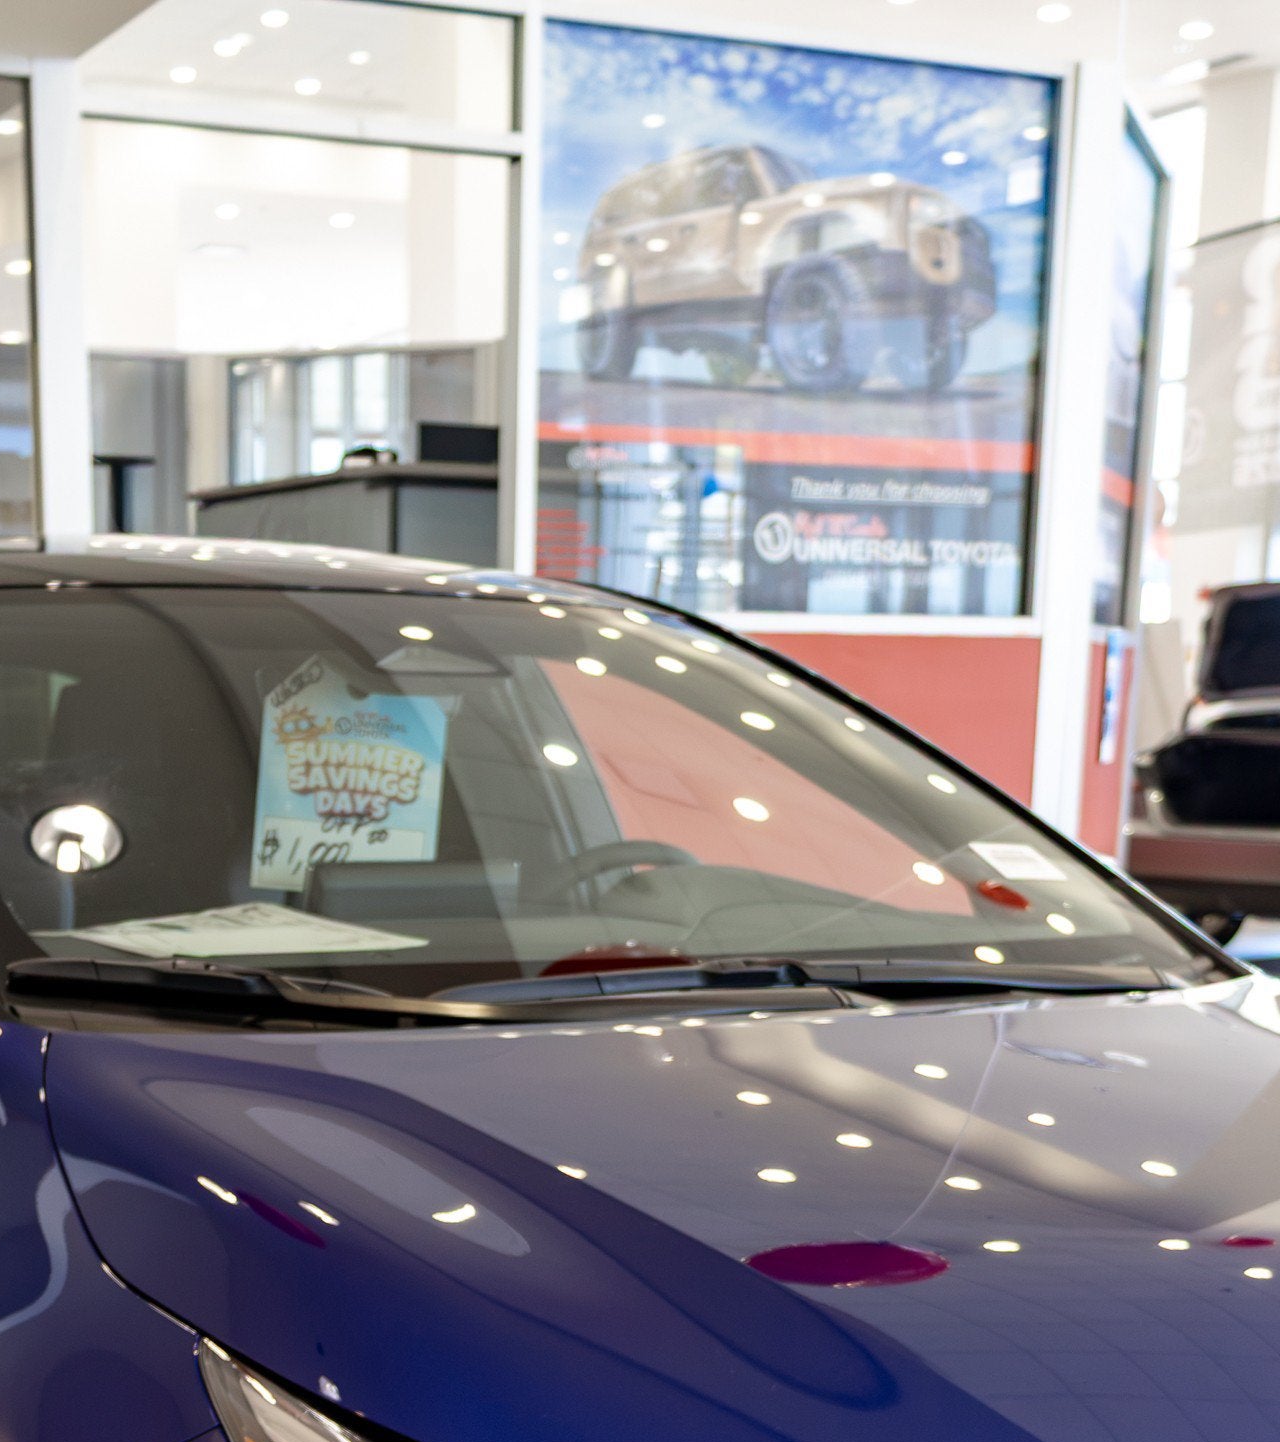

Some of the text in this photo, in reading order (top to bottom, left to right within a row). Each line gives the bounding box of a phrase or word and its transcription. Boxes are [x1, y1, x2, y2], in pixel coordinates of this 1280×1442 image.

[790, 475, 846, 499] Thank
[846, 481, 881, 502] you
[792, 537, 928, 564] UNIVERSAL
[929, 540, 1020, 567] TOYOTA
[286, 740, 424, 777] SUMMER
[287, 765, 420, 803] SAVINGS
[316, 790, 390, 820] DAYS
